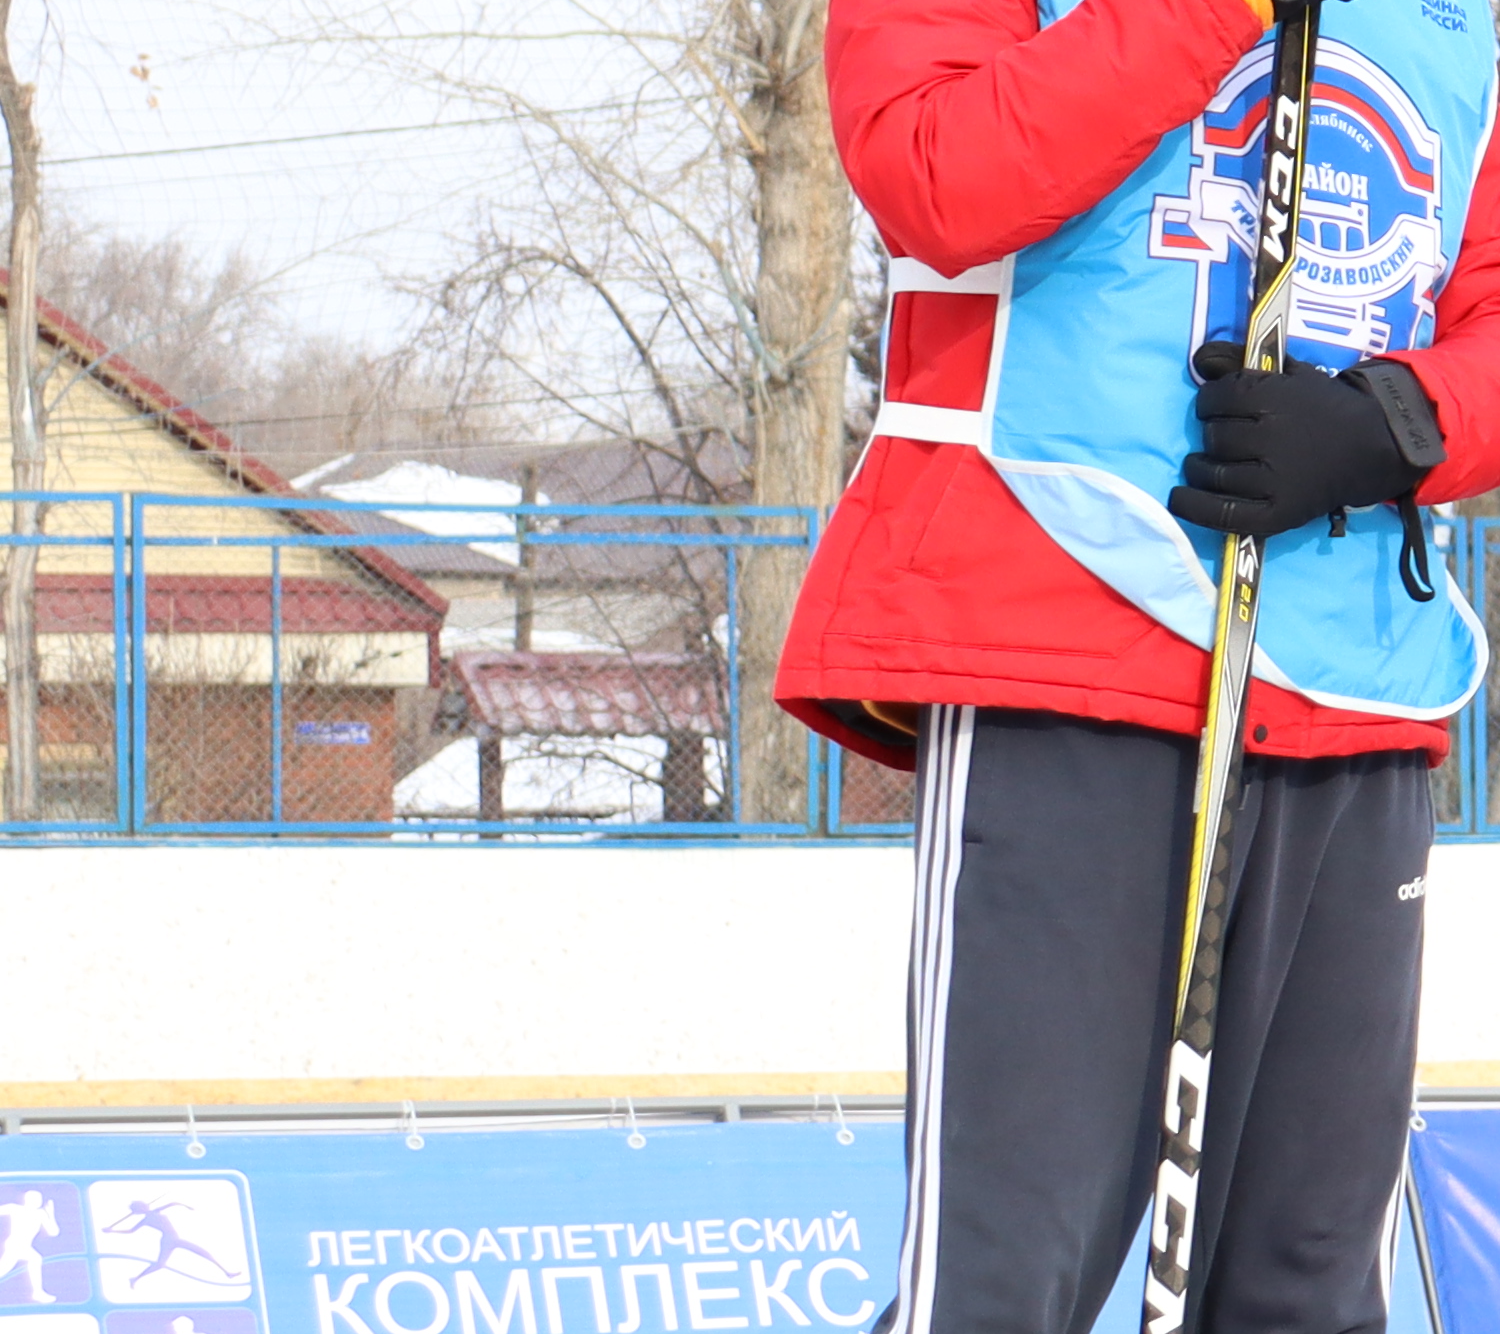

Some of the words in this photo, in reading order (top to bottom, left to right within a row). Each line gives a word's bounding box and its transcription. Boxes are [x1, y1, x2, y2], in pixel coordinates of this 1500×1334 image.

[1309, 112, 1374, 155] лябинск
[1262, 94, 1300, 263] CCM
[1302, 162, 1369, 201] АЙОН
[306, 1210, 863, 1269] ЛЕГКОАТЛЕТИЧЕСКИЙ
